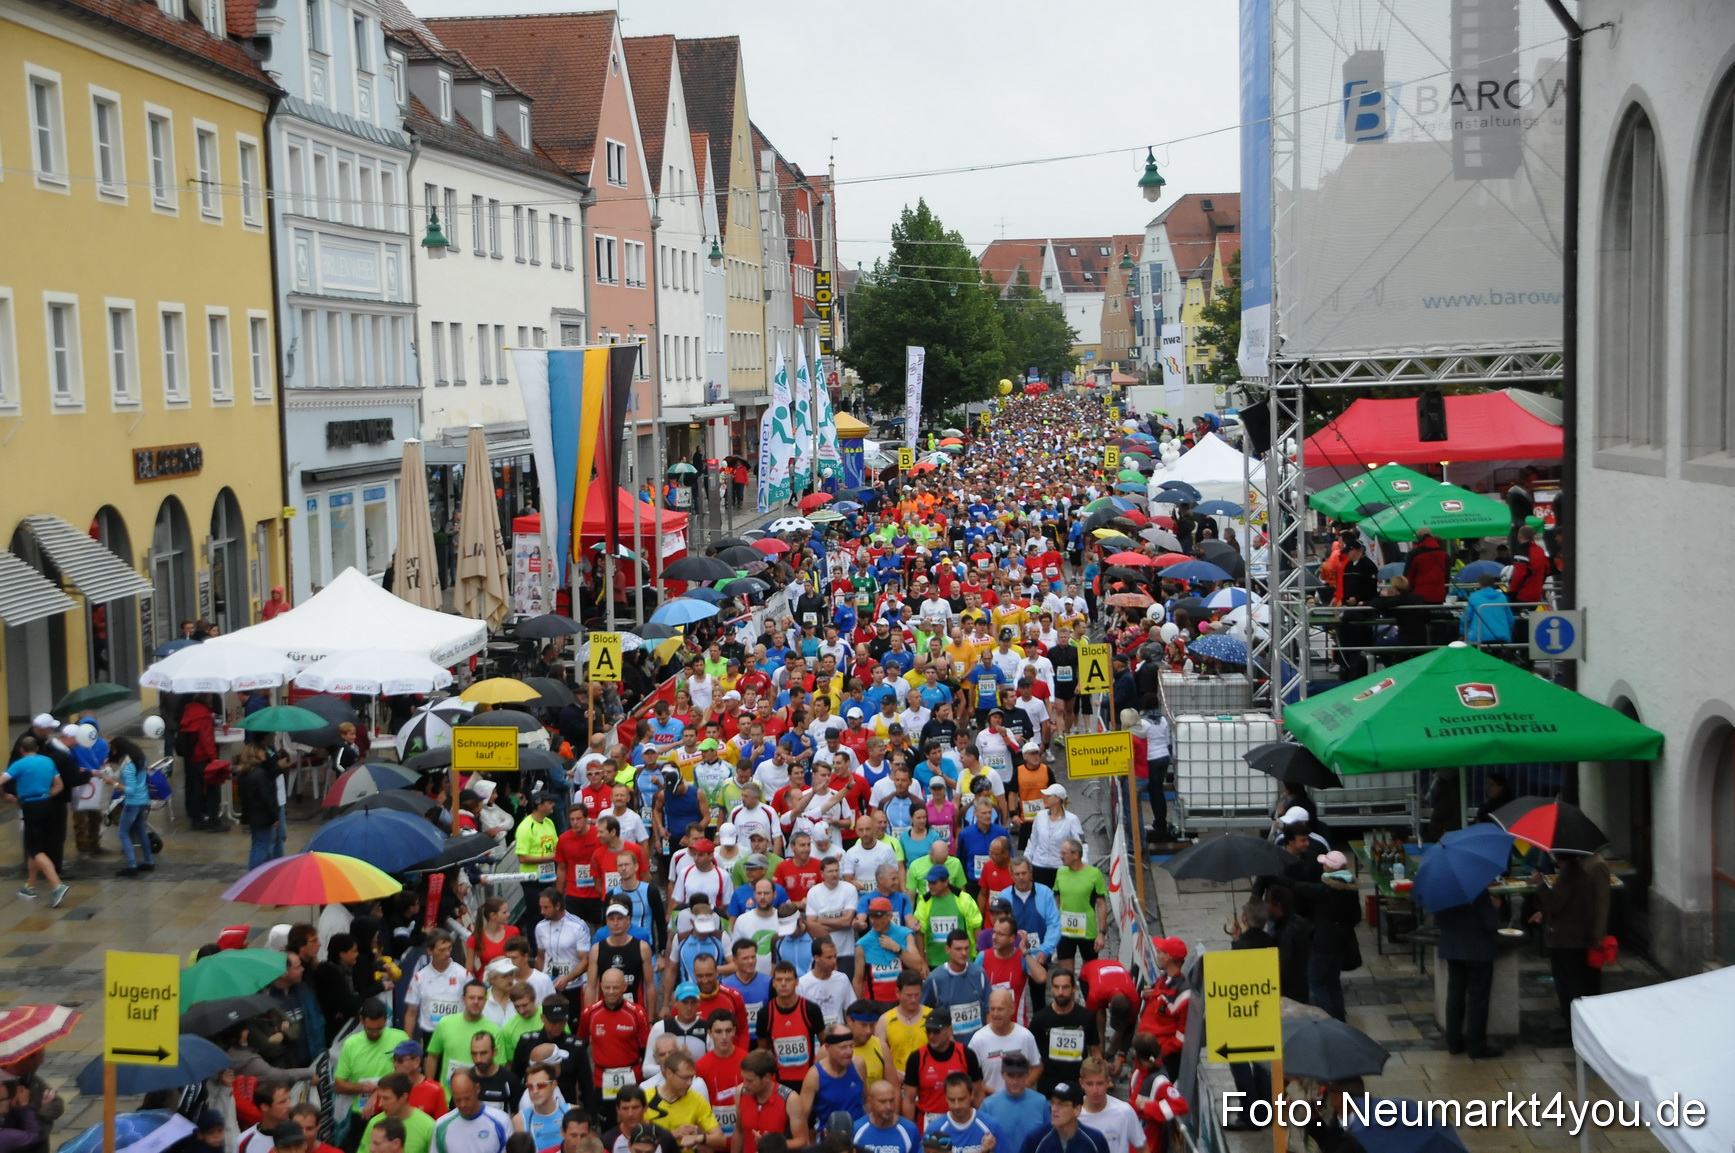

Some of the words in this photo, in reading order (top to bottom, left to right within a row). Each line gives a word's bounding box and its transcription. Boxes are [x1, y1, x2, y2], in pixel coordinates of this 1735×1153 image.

[816, 272, 832, 354] HOTEL
[902, 454, 910, 465] B
[1108, 452, 1116, 463] B
[593, 634, 618, 644] Block
[1081, 645, 1107, 656] Block
[596, 647, 614, 670] A
[1087, 659, 1105, 683] A
[334, 684, 353, 692] Audi
[1439, 711, 1535, 725] Neumarkter
[1423, 721, 1558, 739] Lammsbräu
[457, 739, 513, 749] Schnupper-
[476, 751, 494, 759] lauf
[1070, 745, 1128, 758] Schnupper-
[1090, 756, 1109, 766] lauf
[1067, 917, 1078, 928] 50
[109, 981, 178, 1003] Jugend-
[1208, 978, 1277, 1001] Jugend-
[127, 1003, 160, 1020] lauf
[954, 1008, 978, 1023] 2672
[1228, 1000, 1259, 1018] lauf
[1056, 1036, 1077, 1049] 325
[778, 1043, 805, 1056] 2868
[612, 1073, 626, 1085] 91
